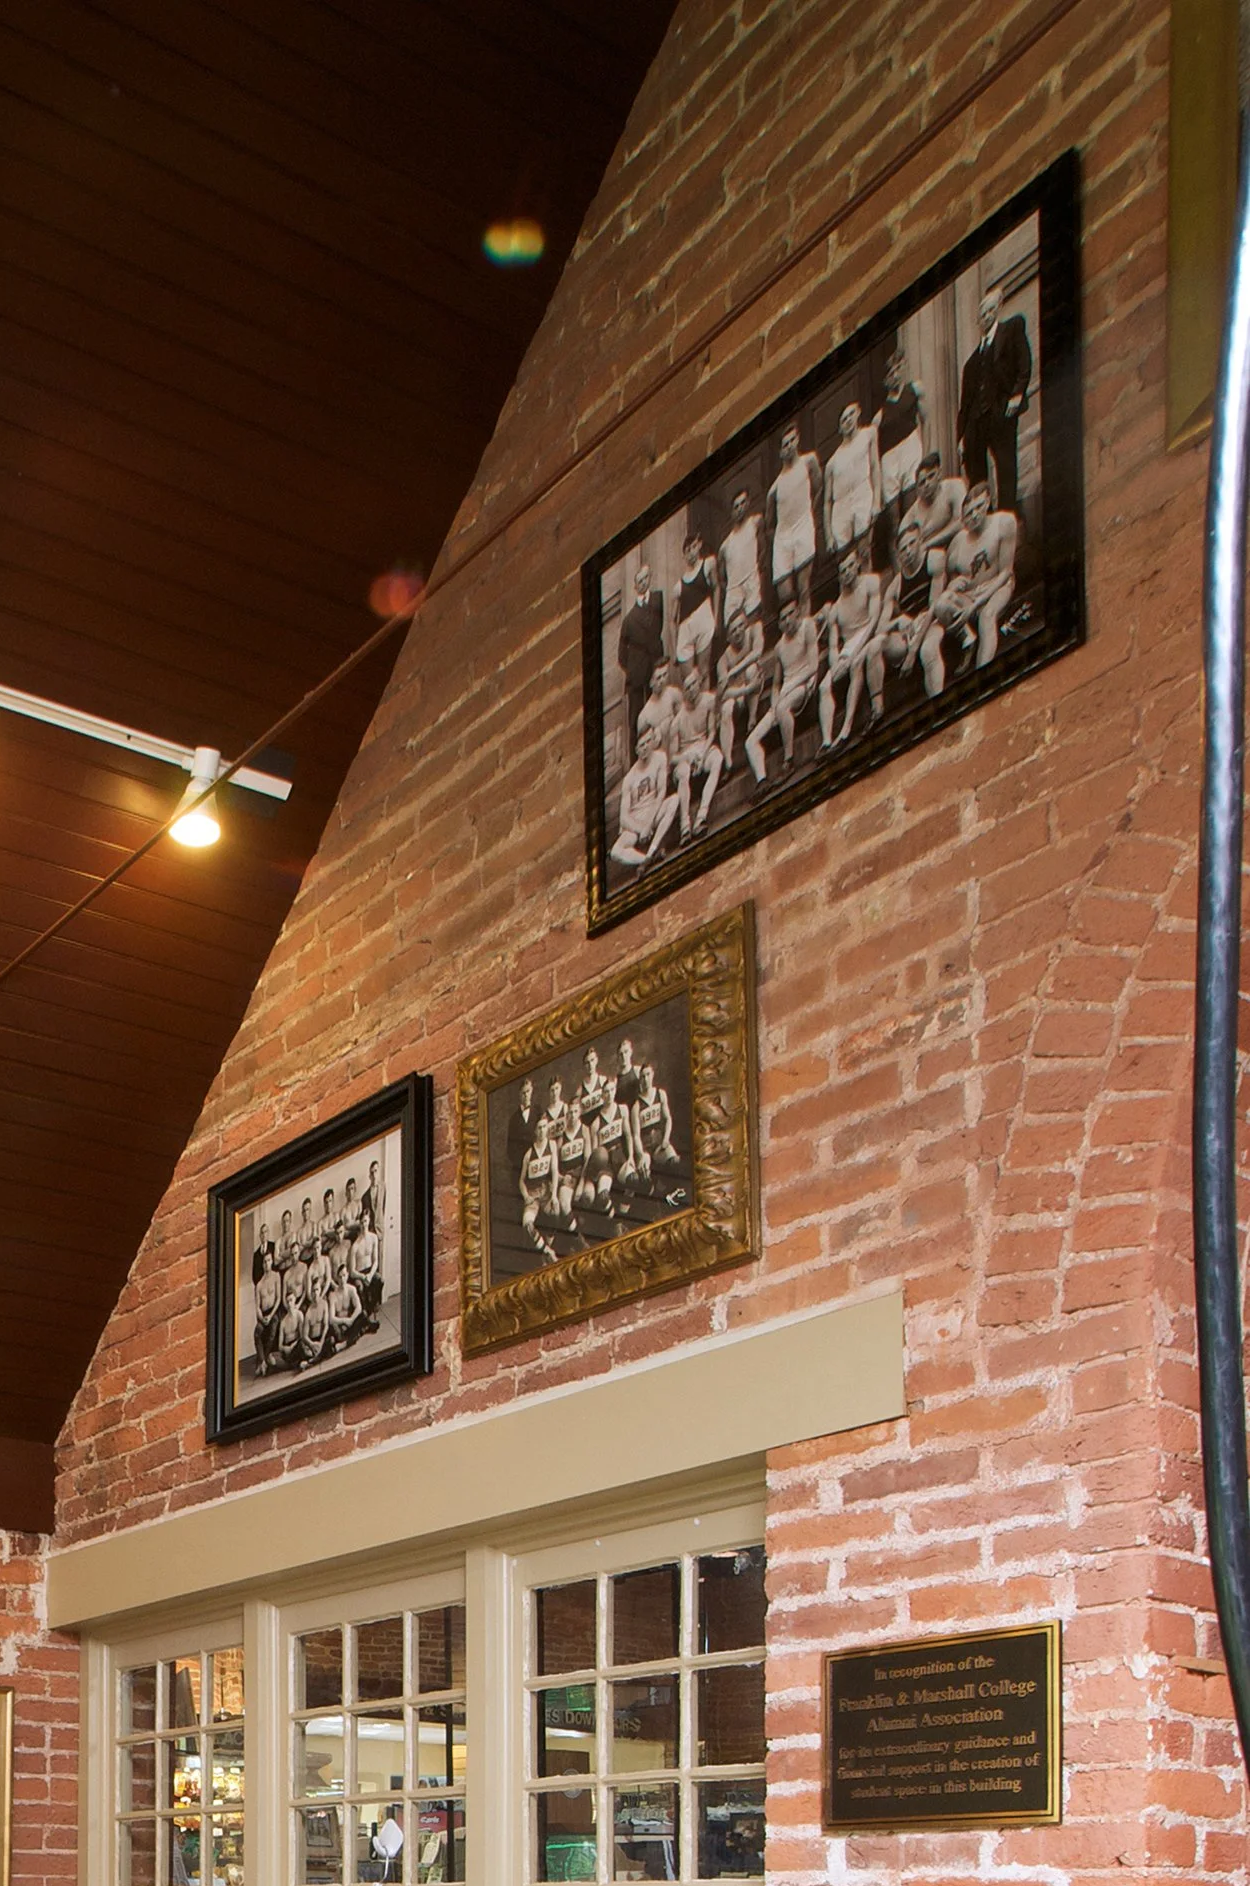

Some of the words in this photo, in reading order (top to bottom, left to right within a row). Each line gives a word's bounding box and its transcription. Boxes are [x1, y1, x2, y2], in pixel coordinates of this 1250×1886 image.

[874, 1668, 888, 1681] In
[889, 1660, 956, 1681] recognition
[957, 1656, 973, 1671] of
[974, 1655, 996, 1669] the
[838, 1693, 894, 1713] Franklin
[896, 1692, 910, 1706] &
[913, 1684, 975, 1705] Marshall
[978, 1679, 1037, 1698] College
[866, 1713, 917, 1734] Alumni
[920, 1707, 1004, 1728] Association
[838, 1747, 856, 1760] for
[873, 1740, 949, 1757] extraordinary
[954, 1735, 1010, 1753] guidance
[1012, 1730, 1037, 1745] and
[836, 1764, 886, 1780] financial
[888, 1761, 932, 1779] support
[934, 1760, 947, 1773] in
[949, 1758, 969, 1773] the
[971, 1755, 1022, 1770] creation
[1024, 1752, 1041, 1767] of
[850, 1785, 891, 1799] student
[893, 1785, 928, 1799] space
[929, 1782, 942, 1795] in
[944, 1780, 967, 1793] this
[969, 1777, 1022, 1794] building
